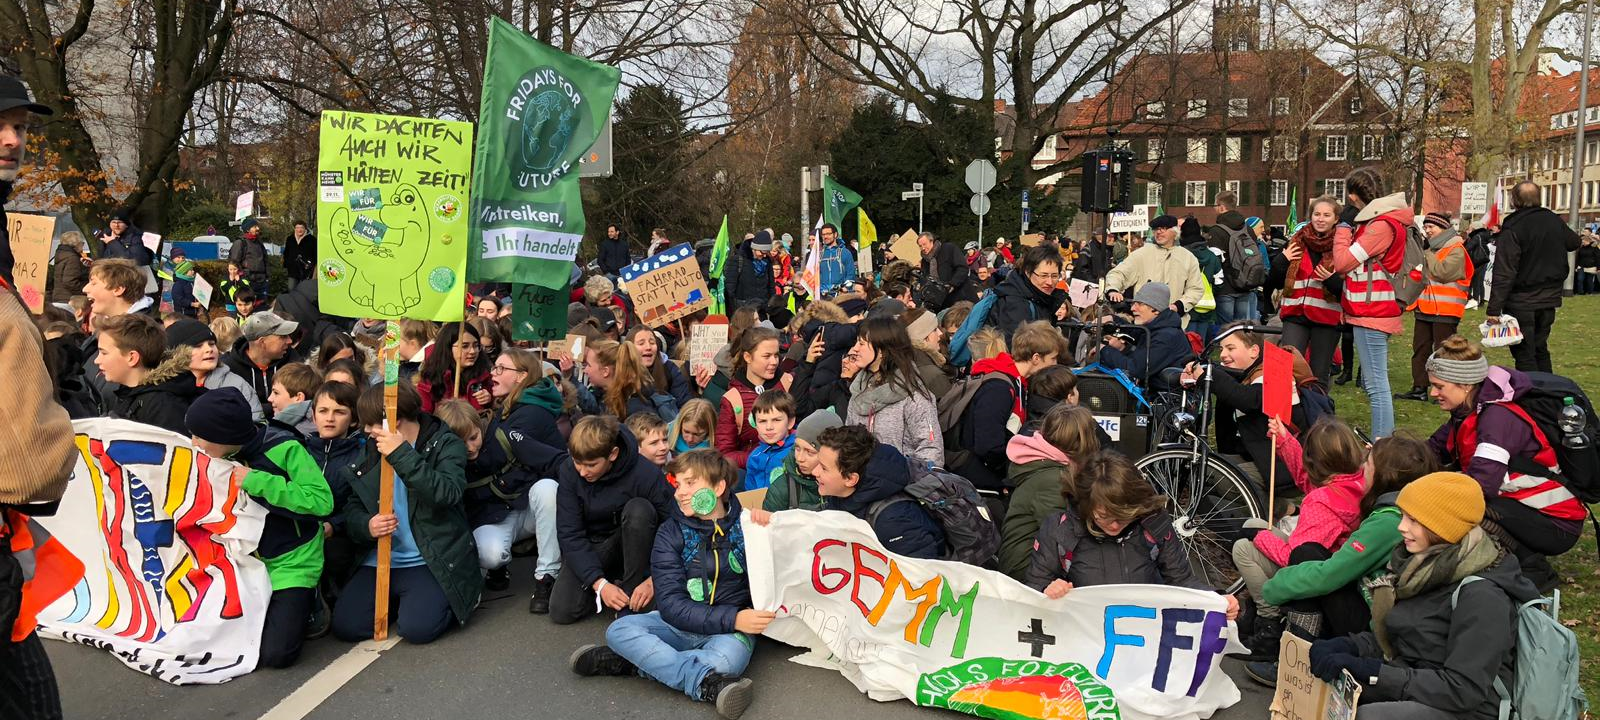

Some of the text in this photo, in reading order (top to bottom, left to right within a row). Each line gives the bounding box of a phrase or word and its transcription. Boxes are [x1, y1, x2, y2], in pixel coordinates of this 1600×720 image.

[506, 69, 581, 121] FRIDAYS FOR
[376, 117, 463, 146] DACHTEN
[339, 133, 442, 164] AUCH WIR
[359, 197, 375, 205] FÜR
[362, 225, 377, 236] FÜR
[495, 233, 520, 252] Ihr
[637, 266, 687, 293] FAHRRAD
[673, 270, 702, 291] AUTO
[529, 304, 542, 318] is
[811, 538, 980, 659] GEMM
[1095, 603, 1229, 698] FFF
[1285, 672, 1302, 689] was
